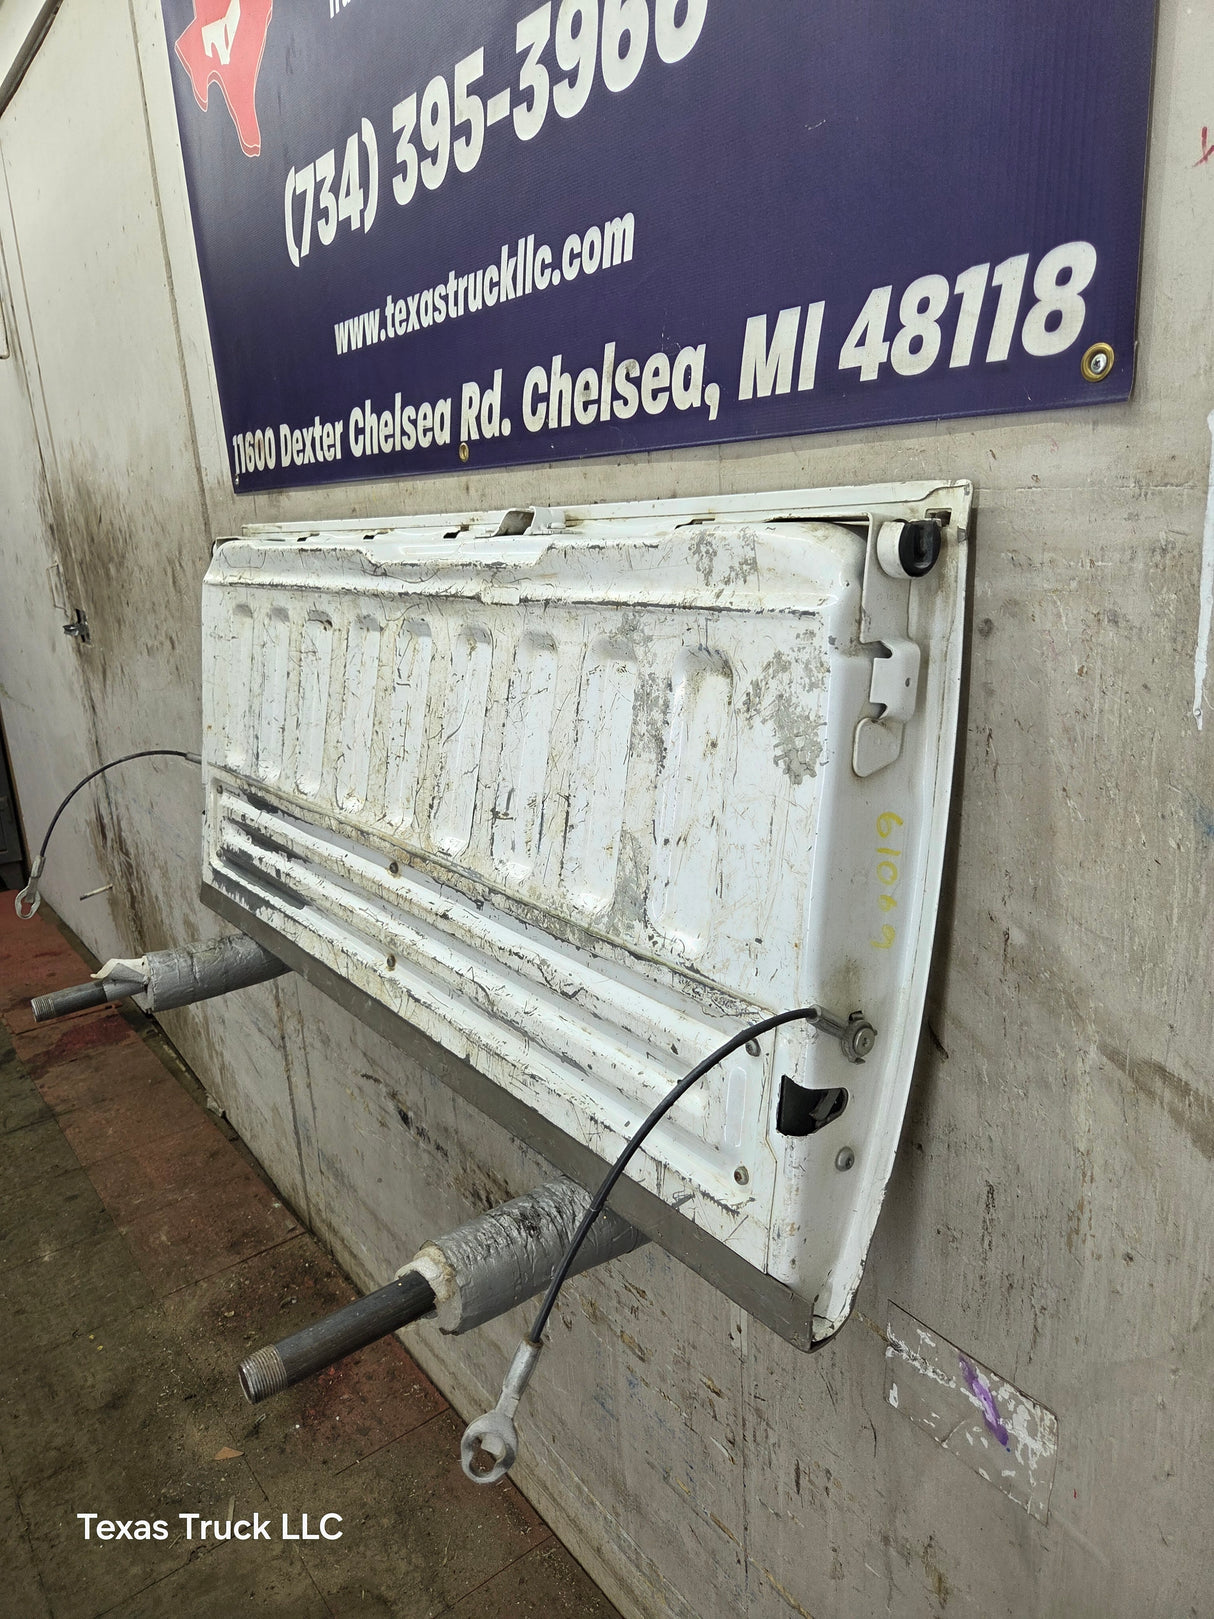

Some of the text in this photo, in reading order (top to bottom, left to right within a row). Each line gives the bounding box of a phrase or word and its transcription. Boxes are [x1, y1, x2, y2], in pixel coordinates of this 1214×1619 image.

[285, 117, 379, 268] (734)
[232, 240, 1098, 476] 11600 Dexter Chelsea Rd. Chelsea, MI 48118
[334, 212, 635, 356] www.texastruckllc.com
